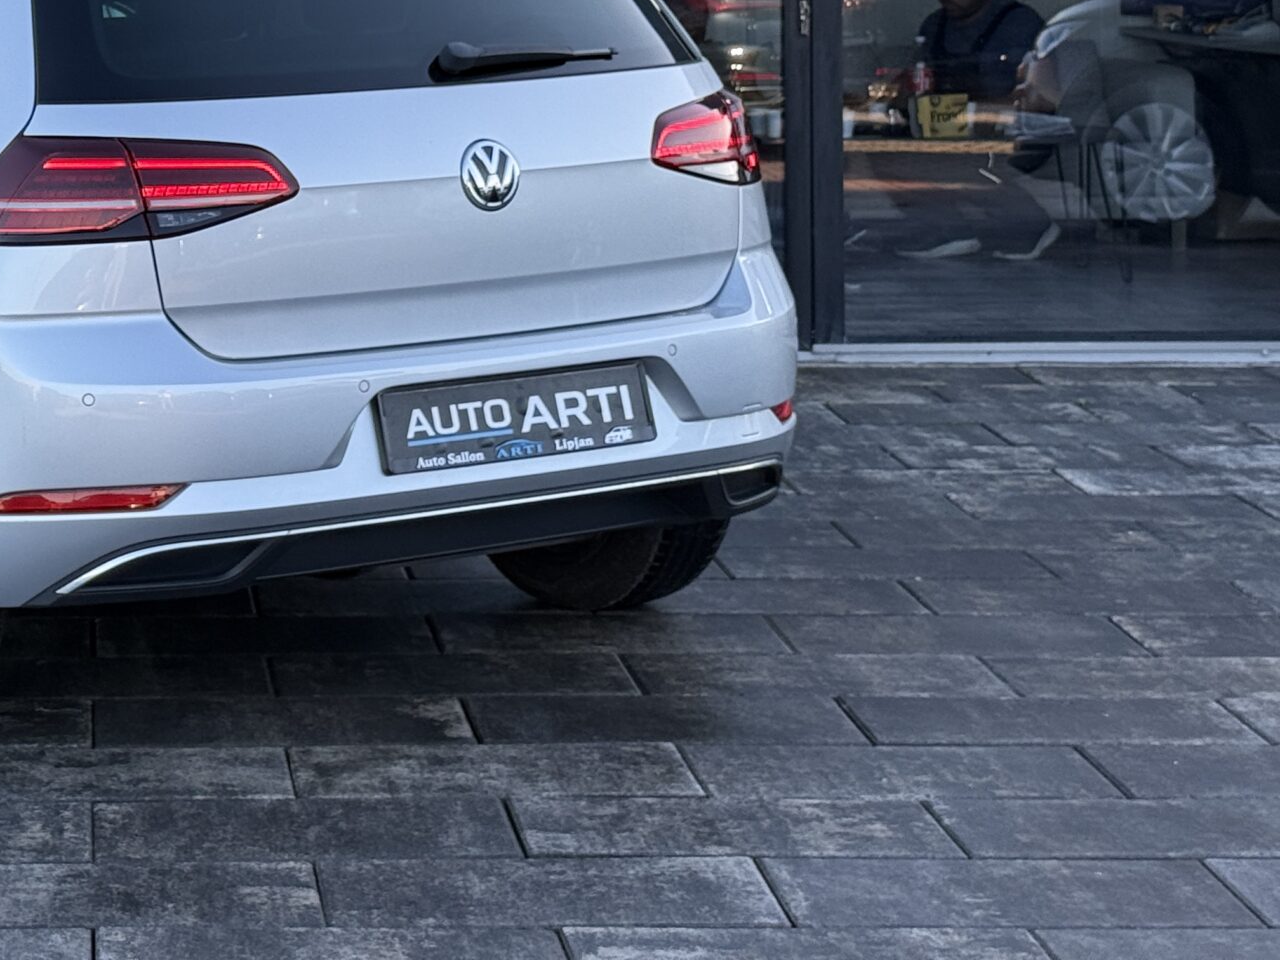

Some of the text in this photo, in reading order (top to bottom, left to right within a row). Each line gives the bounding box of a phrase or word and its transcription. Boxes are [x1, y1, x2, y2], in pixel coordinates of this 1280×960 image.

[407, 385, 634, 439] AUTO ARTI
[417, 456, 446, 469] Auto
[497, 442, 544, 458] ARTI
[555, 436, 594, 451] Lipjan
